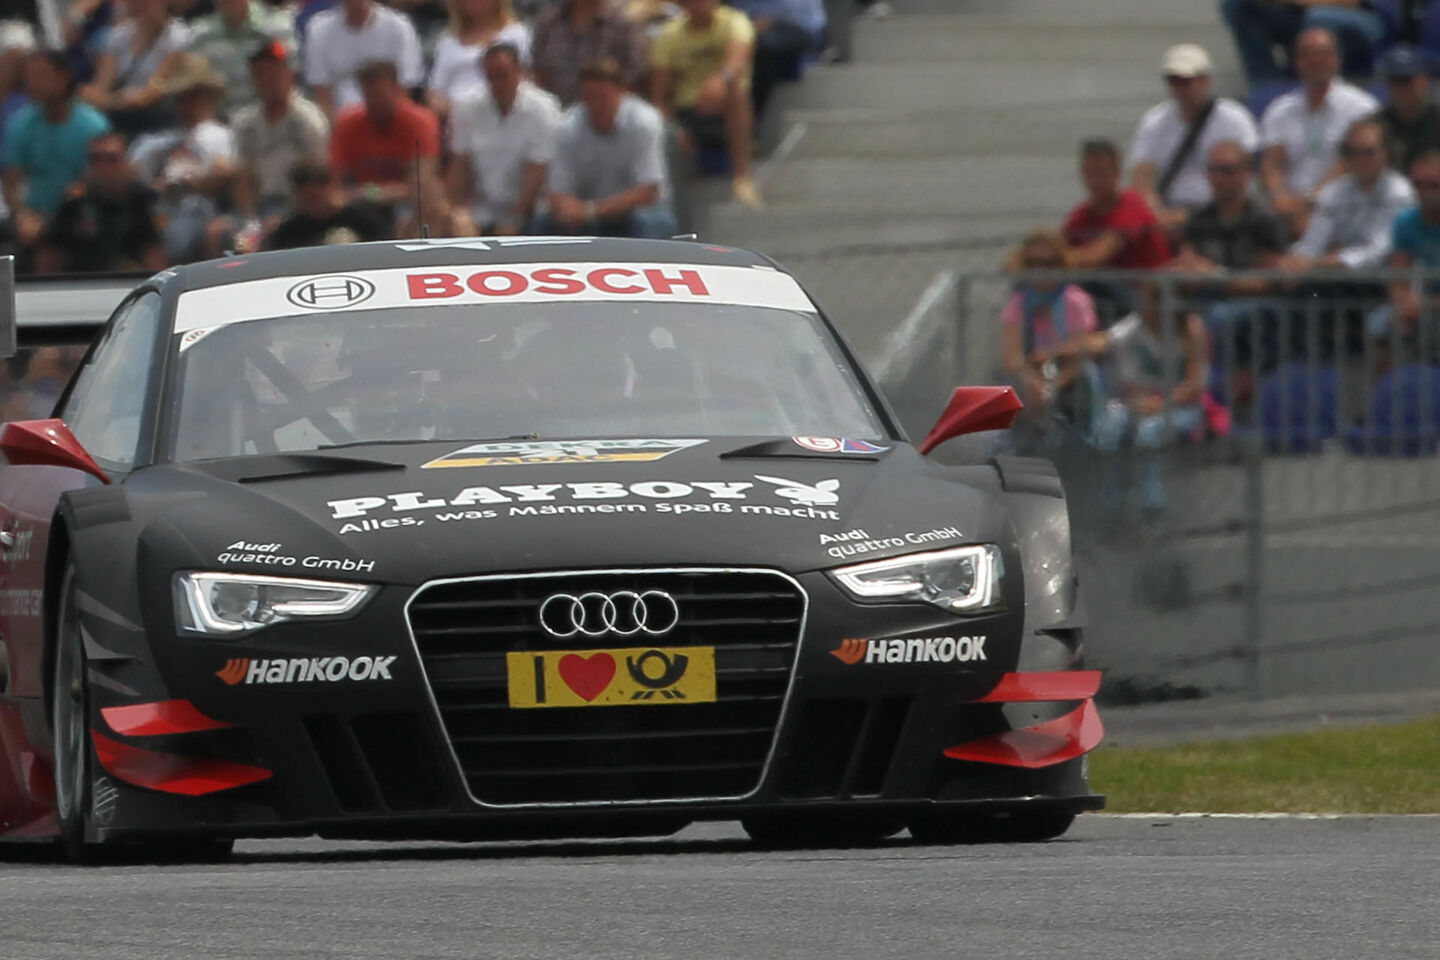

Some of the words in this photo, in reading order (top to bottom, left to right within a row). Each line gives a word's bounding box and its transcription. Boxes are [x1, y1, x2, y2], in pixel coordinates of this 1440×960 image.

[406, 268, 710, 298] BOSCH
[327, 481, 754, 518] PLAYBOY
[339, 515, 425, 534] Alles,
[435, 509, 498, 520] was
[509, 503, 647, 516] Männern
[654, 502, 733, 515] Spaß
[741, 504, 841, 520] macht
[227, 541, 282, 552] Audi
[819, 528, 870, 545] Audi
[828, 537, 905, 559] quattro
[905, 526, 963, 545] GmbH
[217, 552, 296, 566] quattro
[302, 556, 375, 572] GmbH
